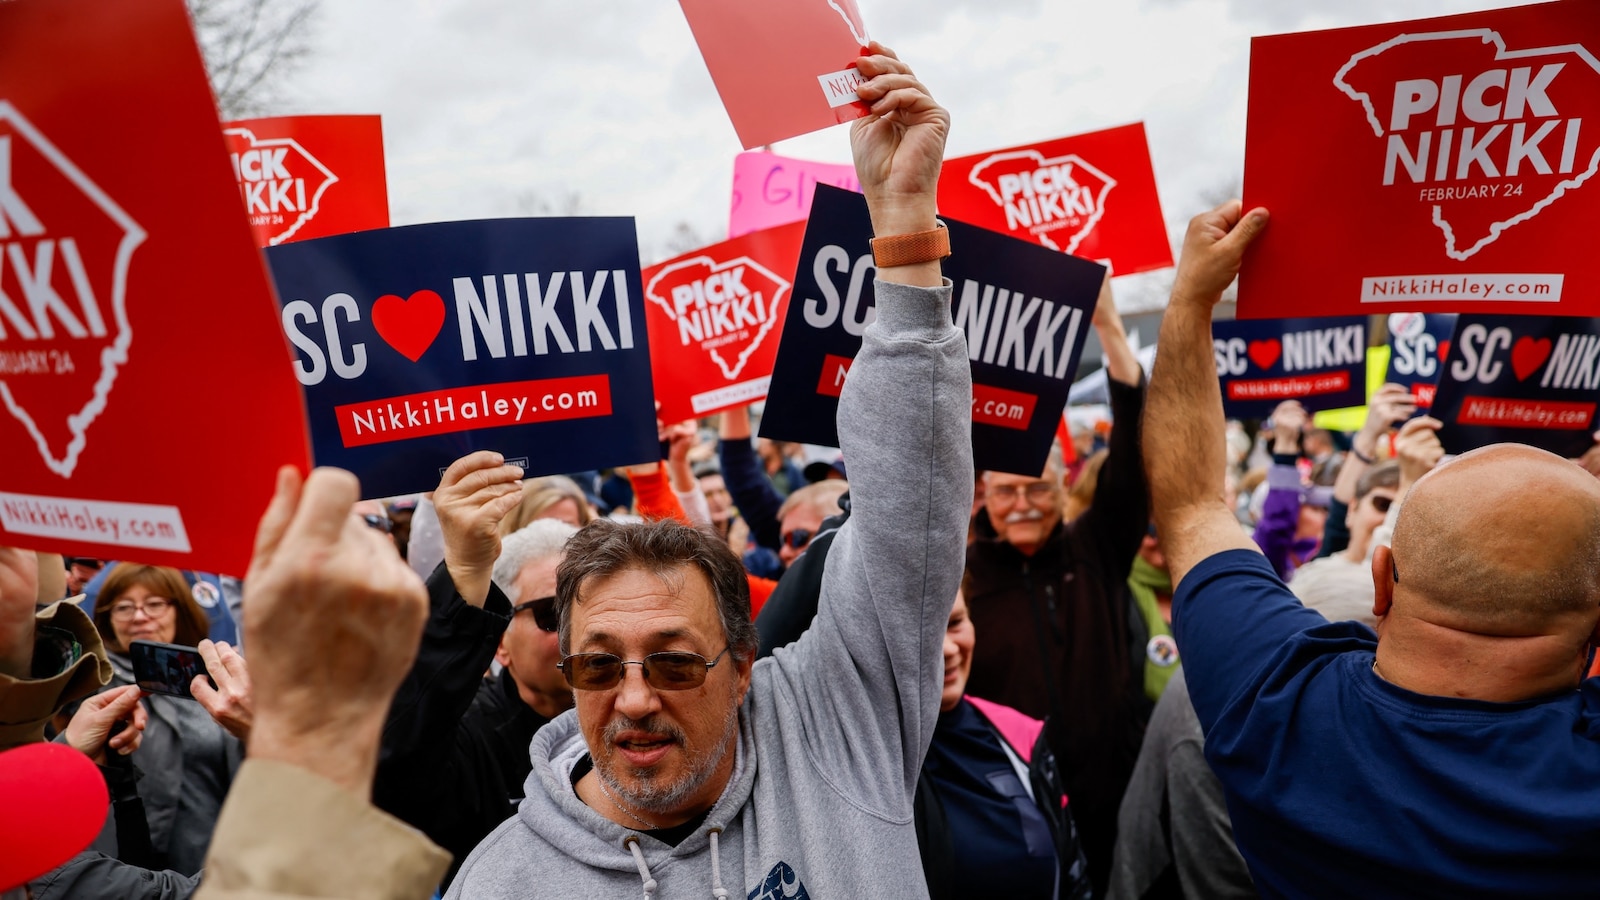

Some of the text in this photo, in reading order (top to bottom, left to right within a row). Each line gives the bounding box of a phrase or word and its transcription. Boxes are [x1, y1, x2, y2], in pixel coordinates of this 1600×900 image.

[828, 72, 871, 98] Nikk
[1390, 62, 1567, 131] PICK
[1382, 118, 1582, 185] NIKKI
[238, 178, 307, 214] KKI
[998, 163, 1080, 202] PICK
[1419, 184, 1523, 202] FEBRUARY 24
[1003, 186, 1095, 231] NIKKI
[672, 267, 750, 317] PICK
[803, 244, 1083, 380] SC NIKKI
[1372, 278, 1550, 298] NikkiHaley.com
[282, 292, 368, 386] SC
[452, 269, 634, 361] NIKKI
[677, 291, 767, 346] NIKKI
[1213, 324, 1364, 377] SC NIKKI
[1394, 332, 1436, 377] SC
[1452, 323, 1512, 384] SC
[351, 388, 598, 436] NikkiHaley.com
[1467, 401, 1587, 427] NikkiHaley.com
[3, 499, 177, 541] NikkiHaley.com
